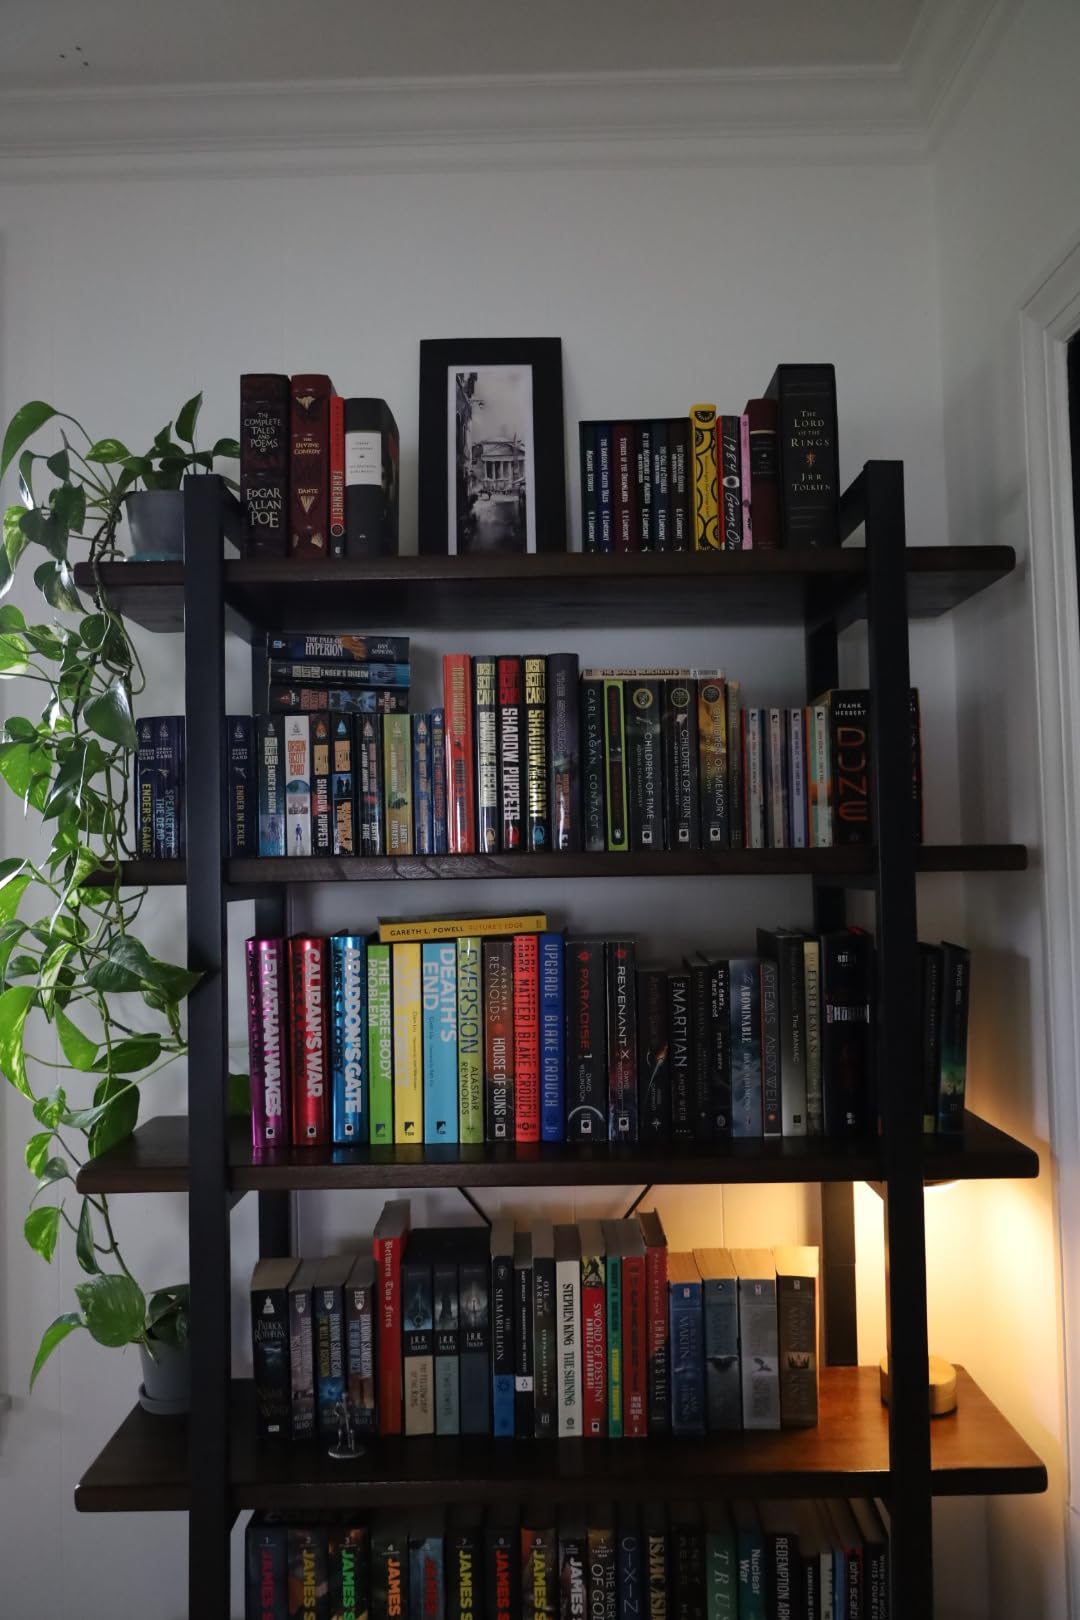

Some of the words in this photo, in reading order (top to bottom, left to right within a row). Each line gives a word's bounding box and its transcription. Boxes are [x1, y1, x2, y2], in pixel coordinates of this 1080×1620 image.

[244, 418, 281, 427] COMPLETE
[251, 426, 275, 434] TALES
[794, 418, 825, 428] LORD
[250, 438, 278, 448] POEMS
[724, 435, 737, 471] 1984
[791, 438, 830, 448] RINGS
[247, 488, 281, 500] EDGAR
[248, 500, 282, 512] ALLAN
[332, 470, 344, 520] FAHRENHEIT
[792, 483, 831, 491] TOLKIEN
[250, 511, 280, 528] POE
[724, 493, 740, 528] George
[305, 643, 343, 656] HYPERION
[587, 688, 596, 719] CARL
[503, 708, 518, 763] SHADOW
[528, 709, 545, 766] SHADOW
[588, 724, 598, 764] SAGAN
[712, 707, 722, 754] CHILDREN
[644, 732, 653, 779] CHILDREN
[681, 729, 689, 776] CHILDREN
[714, 759, 722, 772] OF
[503, 767, 520, 820] PUPPETS
[646, 782, 654, 795] OF
[683, 780, 690, 792] OF
[837, 726, 870, 823] DUNE
[142, 783, 151, 823] ENDER'S
[156, 798, 164, 814] THE
[165, 789, 174, 828] SPEAKER
[236, 785, 244, 809] ENDER
[317, 779, 328, 813] SHADOW
[529, 781, 546, 820] GIANT
[590, 774, 598, 828] CONTACT
[646, 798, 654, 819] TIME
[683, 795, 691, 818] RUIN
[715, 775, 724, 818] MEMORY
[156, 817, 164, 840] DEAD
[236, 812, 244, 821] IN
[236, 824, 244, 847] EXILE
[318, 814, 328, 847] PUPPETS
[142, 826, 151, 854] GAME
[166, 831, 175, 848] FOR
[390, 928, 421, 936] GARETH
[433, 926, 464, 934] POWELL
[334, 949, 343, 992] JAMES
[379, 958, 390, 985] THE
[518, 944, 530, 973] DARK
[544, 944, 557, 998] UPGRADE
[261, 949, 279, 1051] LEVIATHAN
[304, 948, 321, 1049] CALIBAN'S
[345, 946, 361, 1062] ABADDON'S
[368, 960, 378, 1026] PROBLEM
[423, 962, 439, 1010] END
[440, 949, 456, 1042] DEATH'S
[460, 950, 479, 1053] EVERSION
[489, 956, 500, 1021] REYNOLDS
[518, 979, 531, 1021] MATTER
[764, 964, 775, 1024] ARTEMIS
[579, 968, 589, 1049] PARADISE
[616, 966, 626, 1047] REVENANT
[621, 1050, 629, 1059] X
[673, 989, 688, 1068] MARTIAN
[741, 985, 752, 1043] ABOMINABLE
[808, 970, 817, 1053] FISHERMAN
[334, 1027, 343, 1075] COREY
[380, 990, 392, 1080] THREE-BODY
[519, 1032, 532, 1066] BLAKE
[544, 1015, 557, 1051] BLAKE
[306, 1050, 323, 1098] WAR
[492, 1038, 506, 1071] HOUSE
[765, 1035, 777, 1073] ANDY
[264, 1050, 281, 1116] WAKES
[345, 1062, 362, 1113] GATE
[461, 1062, 469, 1116] REYNOLDS
[494, 1074, 506, 1086] OF
[518, 1073, 531, 1118] CROUCH
[545, 1057, 558, 1107] CROUCH
[767, 1076, 777, 1111] WEIR
[494, 1088, 507, 1115] SUNS
[384, 1240, 393, 1277] Between
[385, 1280, 394, 1301] Two
[563, 1284, 573, 1322] STEPHEN
[385, 1303, 394, 1328] Fires
[495, 1288, 504, 1360] SILMARILLION
[563, 1324, 574, 1345] KING
[593, 1303, 602, 1341] SWORD
[594, 1345, 602, 1357] OF
[654, 1319, 665, 1374] CHAUCER'S
[679, 1315, 689, 1359] MARTIN
[564, 1352, 574, 1368] THE
[564, 1371, 575, 1406] SHINING
[594, 1362, 603, 1403] DESTINY
[655, 1379, 665, 1400] TALE
[261, 1550, 273, 1608] JAMES
[303, 1549, 316, 1608] JAMES
[341, 1550, 356, 1608] JAMES
[459, 1549, 473, 1608] JAMES
[496, 1550, 509, 1608] JAMES
[533, 1549, 548, 1608] JAMES
[592, 1564, 604, 1587] OF
[606, 1560, 616, 1588] THE
[622, 1536, 639, 1618] CIXIN
[649, 1536, 666, 1584] ISAAC
[739, 1560, 750, 1584] War
[752, 1549, 760, 1595] Nuclear
[776, 1537, 790, 1600] REDEMPTION
[387, 1558, 400, 1617] JAMES
[570, 1557, 583, 1615] JAMES
